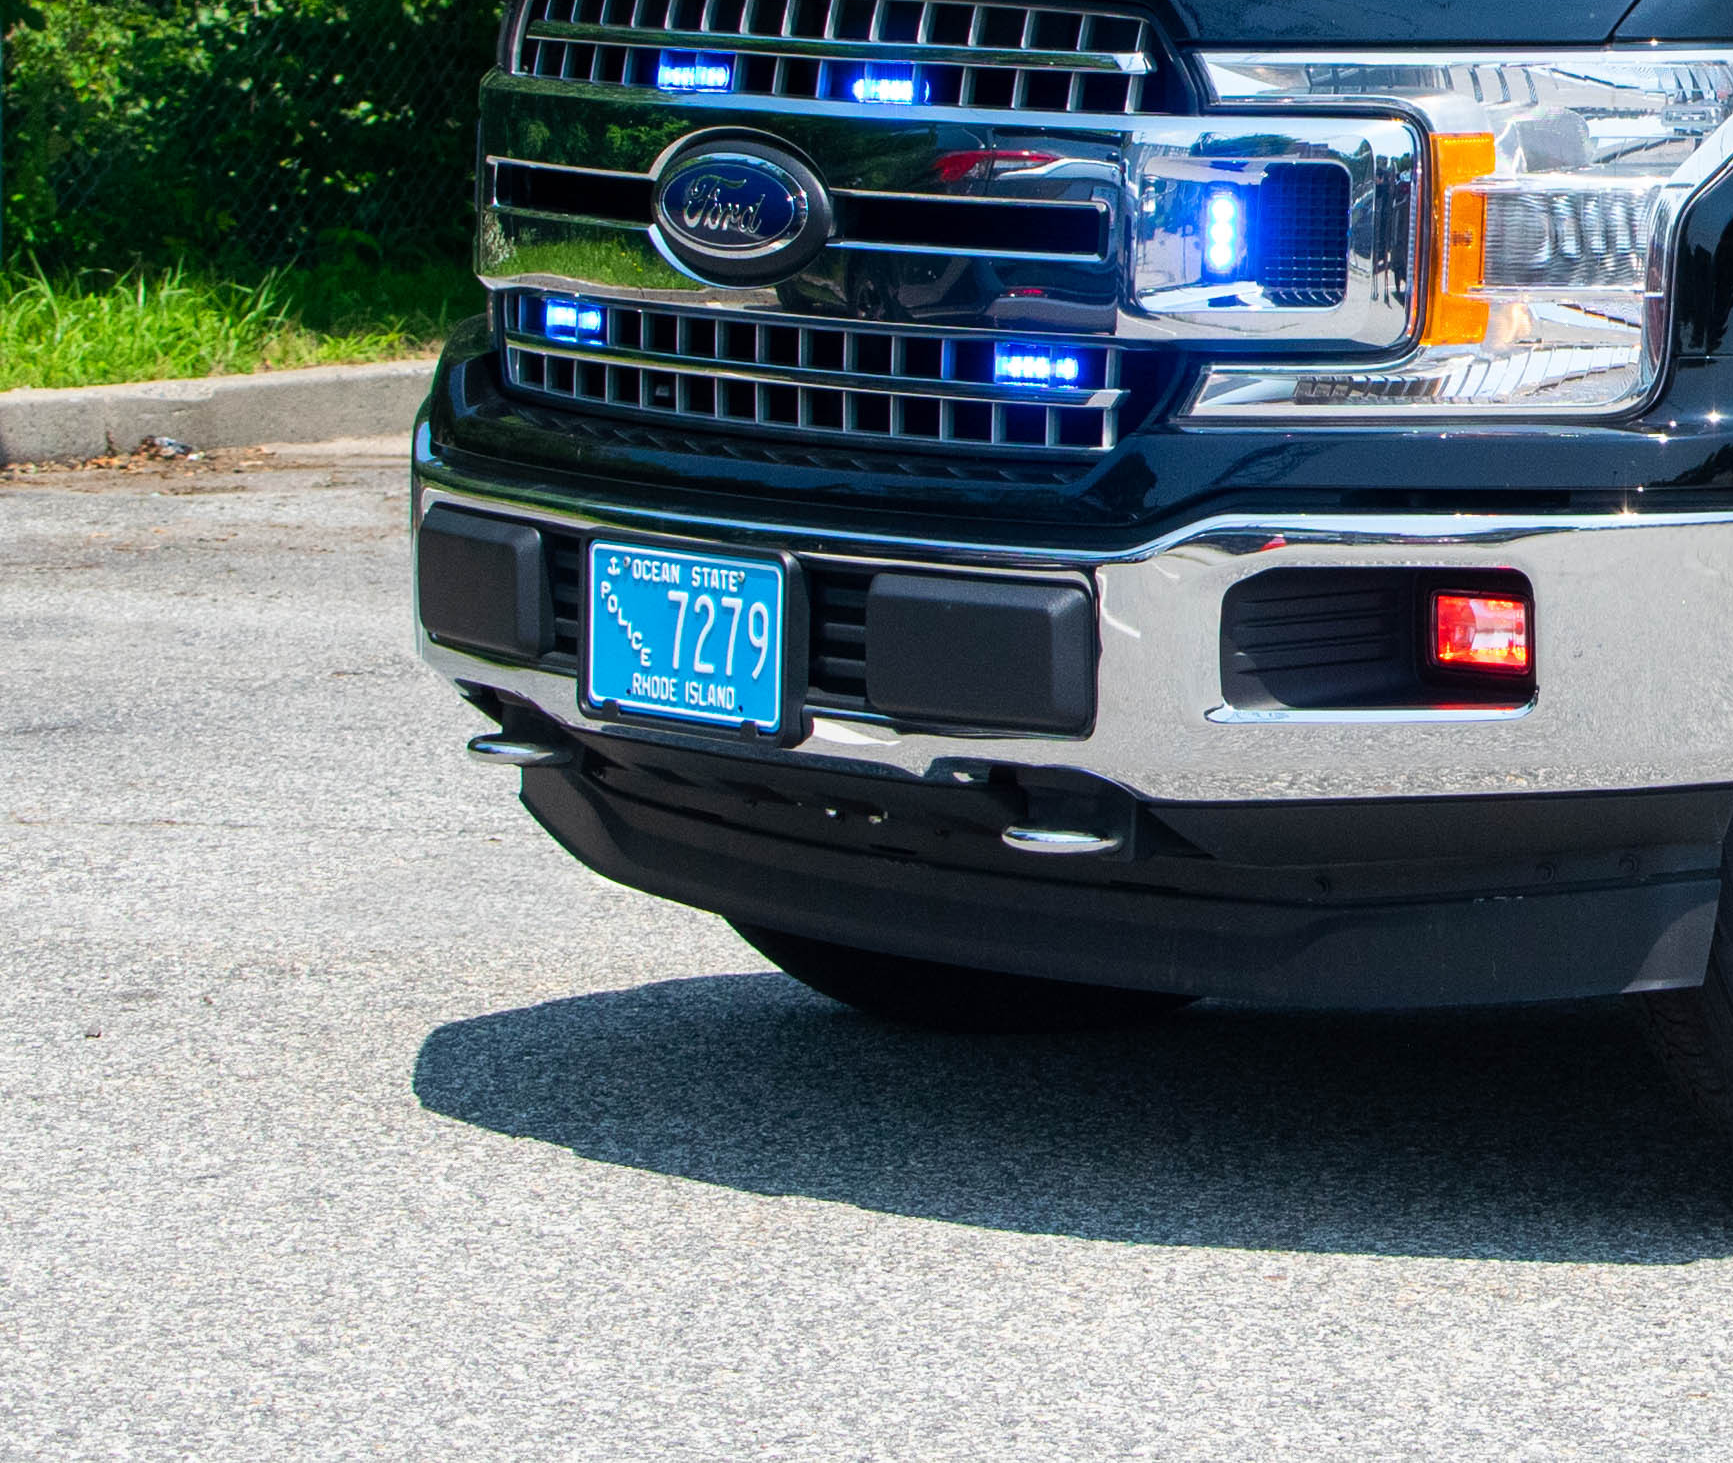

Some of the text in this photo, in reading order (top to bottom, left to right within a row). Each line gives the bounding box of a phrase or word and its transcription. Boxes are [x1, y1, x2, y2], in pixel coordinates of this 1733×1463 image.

[683, 174, 765, 233] Ford
[631, 559, 739, 592] OCEAN STATE
[600, 581, 652, 667] POLICE
[667, 590, 769, 680] 7279
[631, 672, 735, 710] RHODE ISLAND
